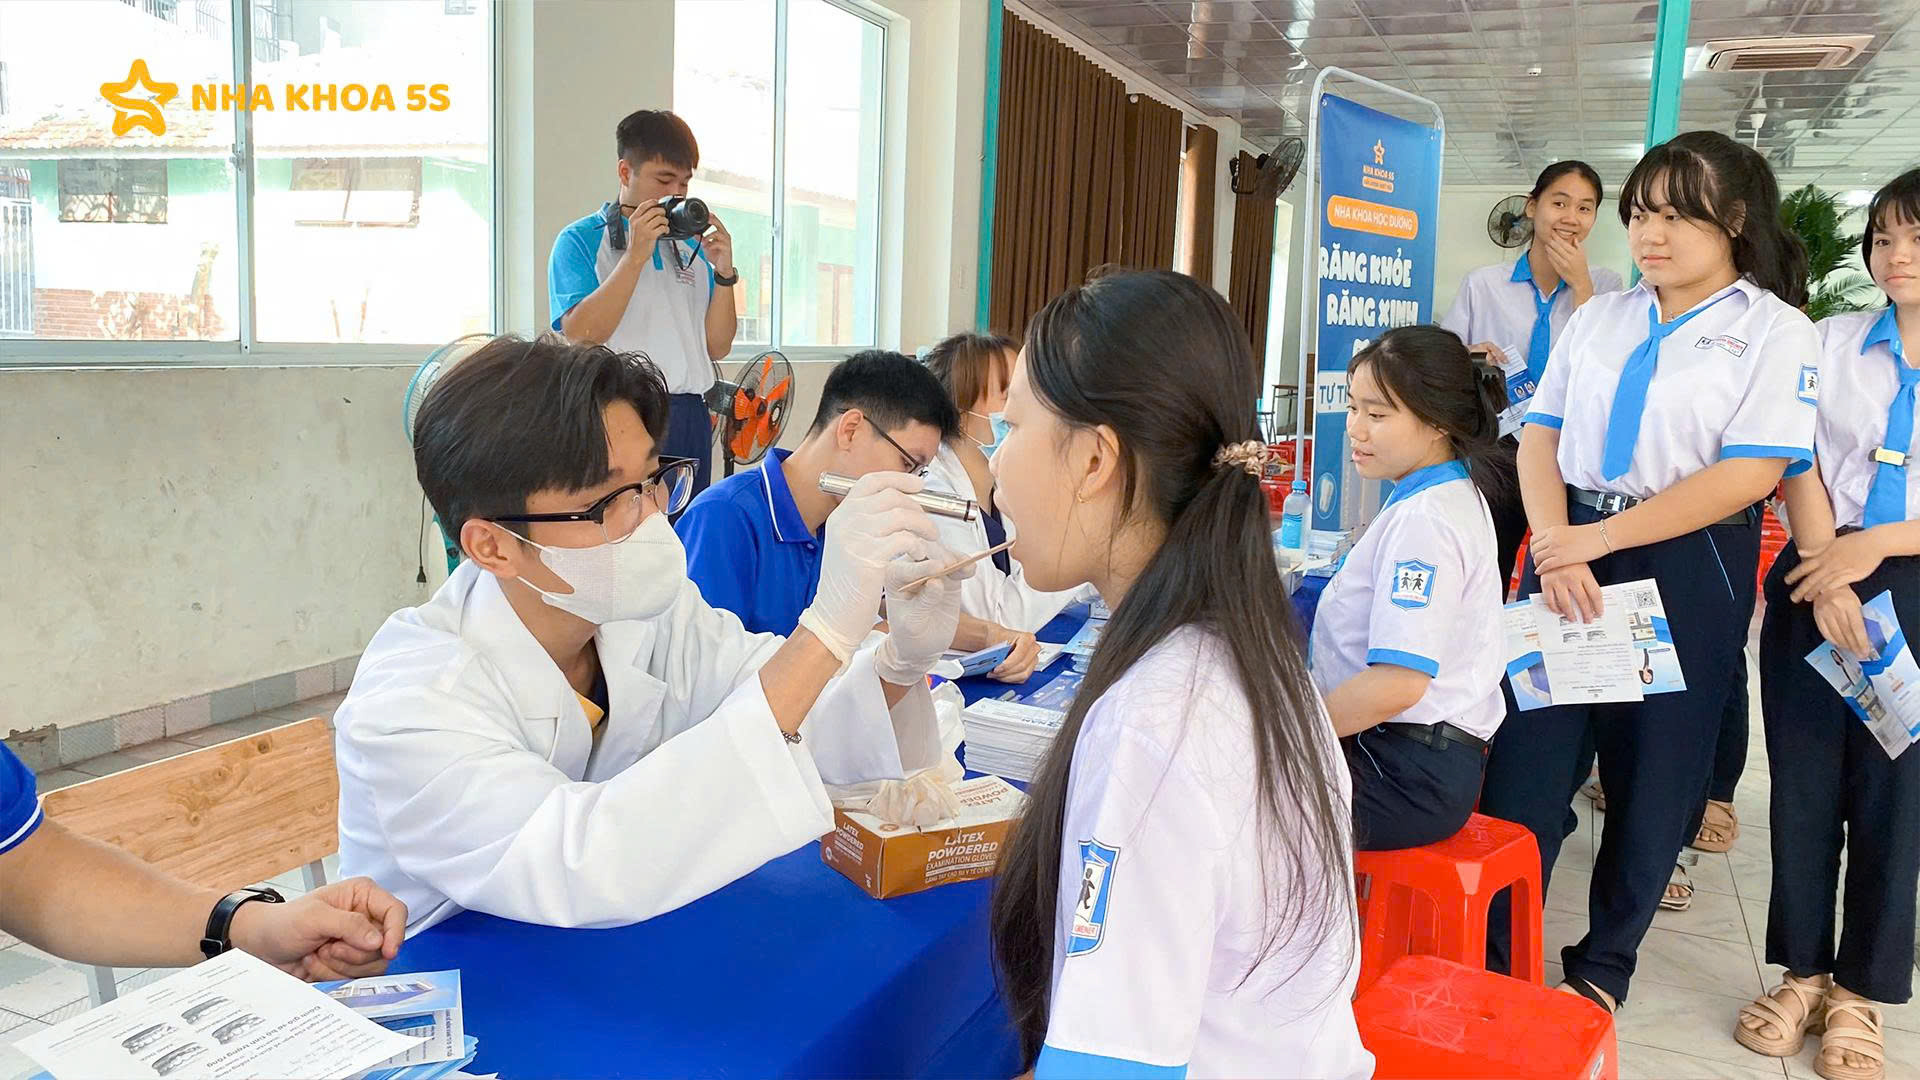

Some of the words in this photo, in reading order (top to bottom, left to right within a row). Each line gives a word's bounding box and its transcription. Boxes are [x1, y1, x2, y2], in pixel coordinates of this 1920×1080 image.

[1334, 205, 1351, 219] NHA
[1352, 207, 1373, 223] KHOA
[1320, 242, 1367, 283] RĂNG
[1369, 247, 1412, 288] KHỎE
[1327, 288, 1376, 327] RĂNG
[1378, 298, 1419, 328] XINH
[1320, 382, 1335, 410] TỰ
[1337, 384, 1347, 404] TI
[945, 830, 985, 846] LATEX
[928, 842, 998, 862] POWDERED
[926, 855, 971, 871] EXAMINATION
